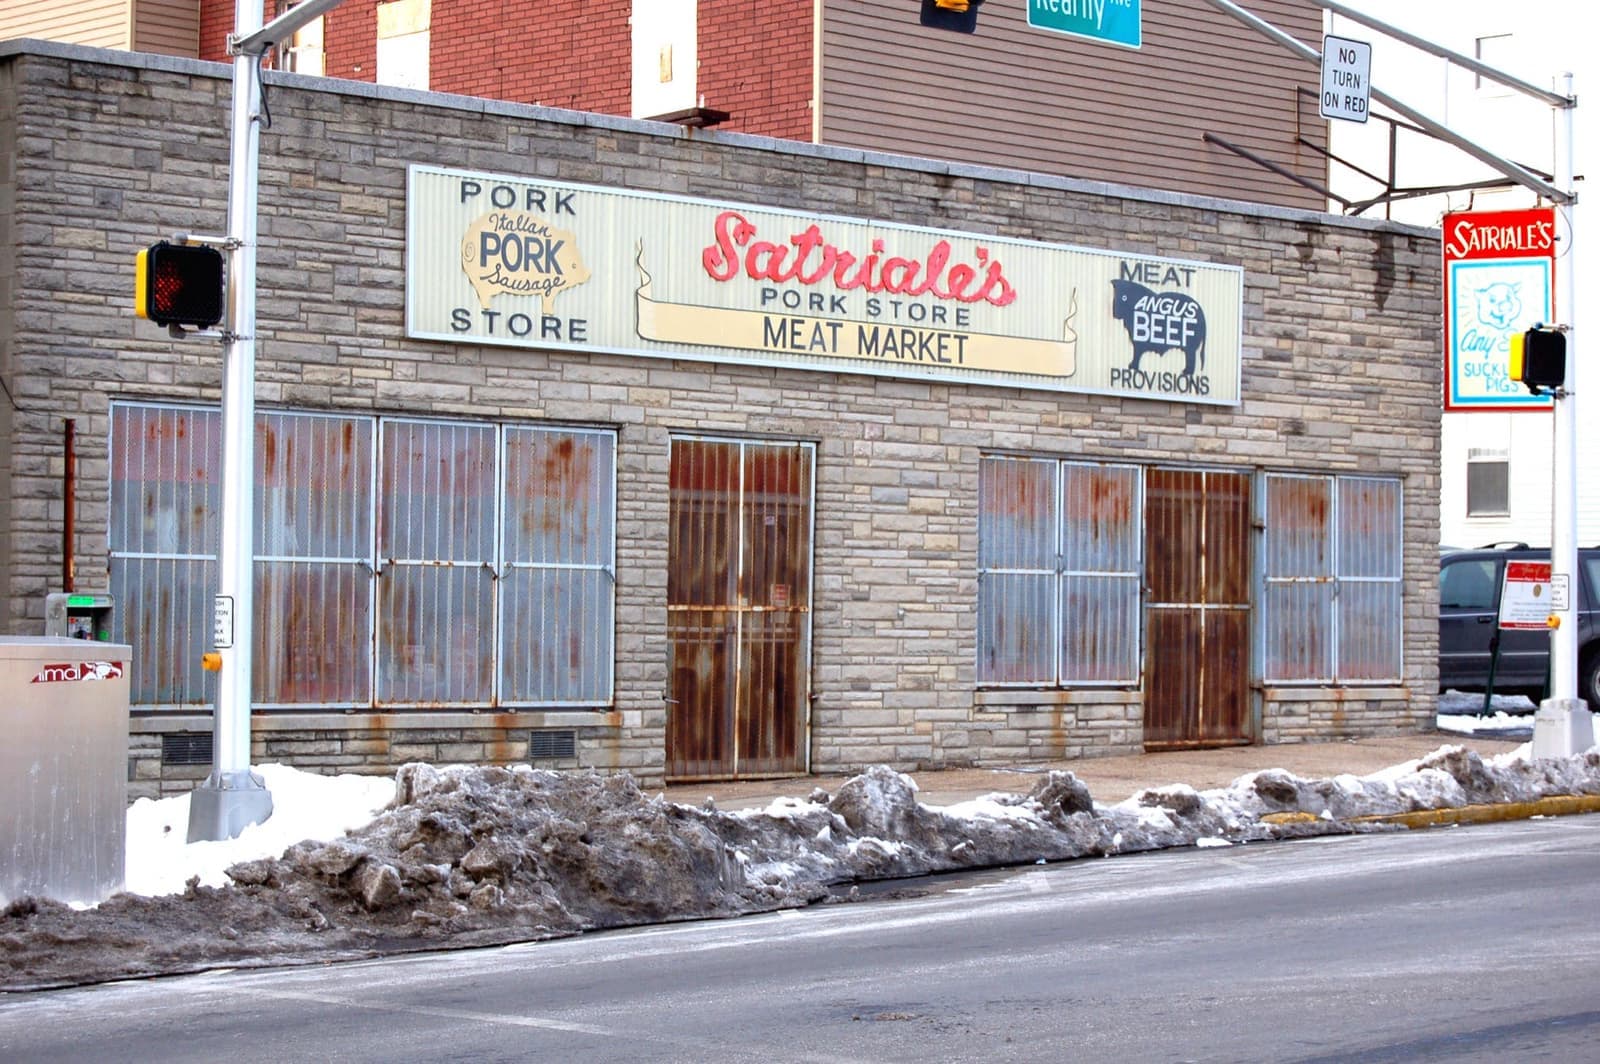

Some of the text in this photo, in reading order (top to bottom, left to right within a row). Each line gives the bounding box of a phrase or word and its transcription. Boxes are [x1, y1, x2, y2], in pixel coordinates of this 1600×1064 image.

[1339, 47, 1356, 65] NO
[1332, 69, 1361, 89] TURN
[1324, 91, 1366, 113] ON RED
[460, 181, 576, 216] PORK
[488, 213, 552, 238] Italian
[1445, 220, 1553, 259] SATRIALE'S
[479, 231, 565, 275] PORK
[702, 211, 1018, 307] Satriale's
[479, 263, 567, 298] Sausage
[1120, 260, 1197, 288] MEAT
[760, 287, 970, 326] PORK STORE
[1134, 295, 1199, 319] ANGUS
[450, 308, 588, 342] STORE
[763, 316, 969, 364] MEAT MARKET
[1133, 310, 1198, 347] BEEF
[1110, 367, 1210, 395] PROVISIONS
[1463, 361, 1509, 377] SUCKL
